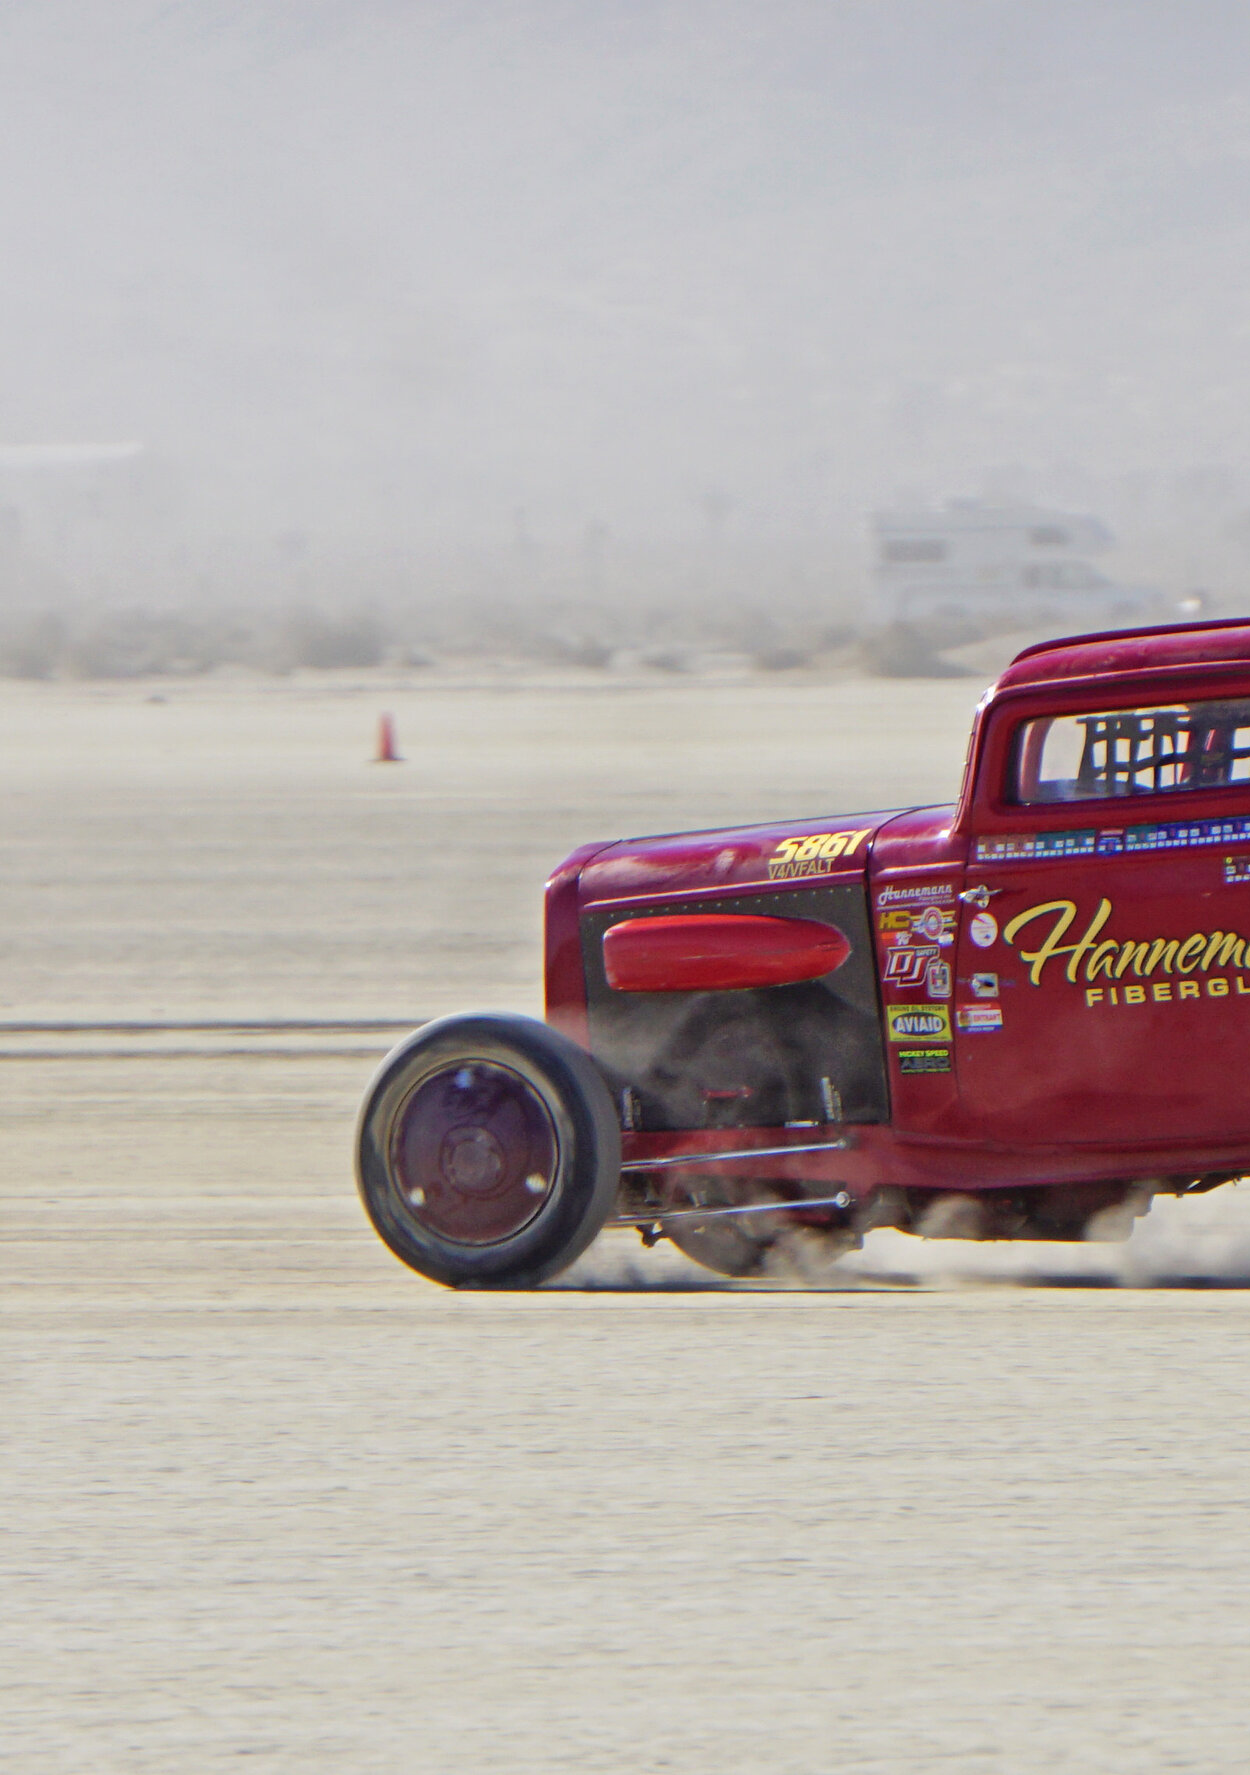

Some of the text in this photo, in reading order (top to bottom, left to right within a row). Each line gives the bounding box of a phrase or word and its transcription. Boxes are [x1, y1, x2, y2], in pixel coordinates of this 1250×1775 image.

[769, 830, 872, 865] 5861
[768, 858, 835, 880] V4/VFALT
[878, 884, 953, 906] Hannemann
[895, 1014, 944, 1034] AVIAID
